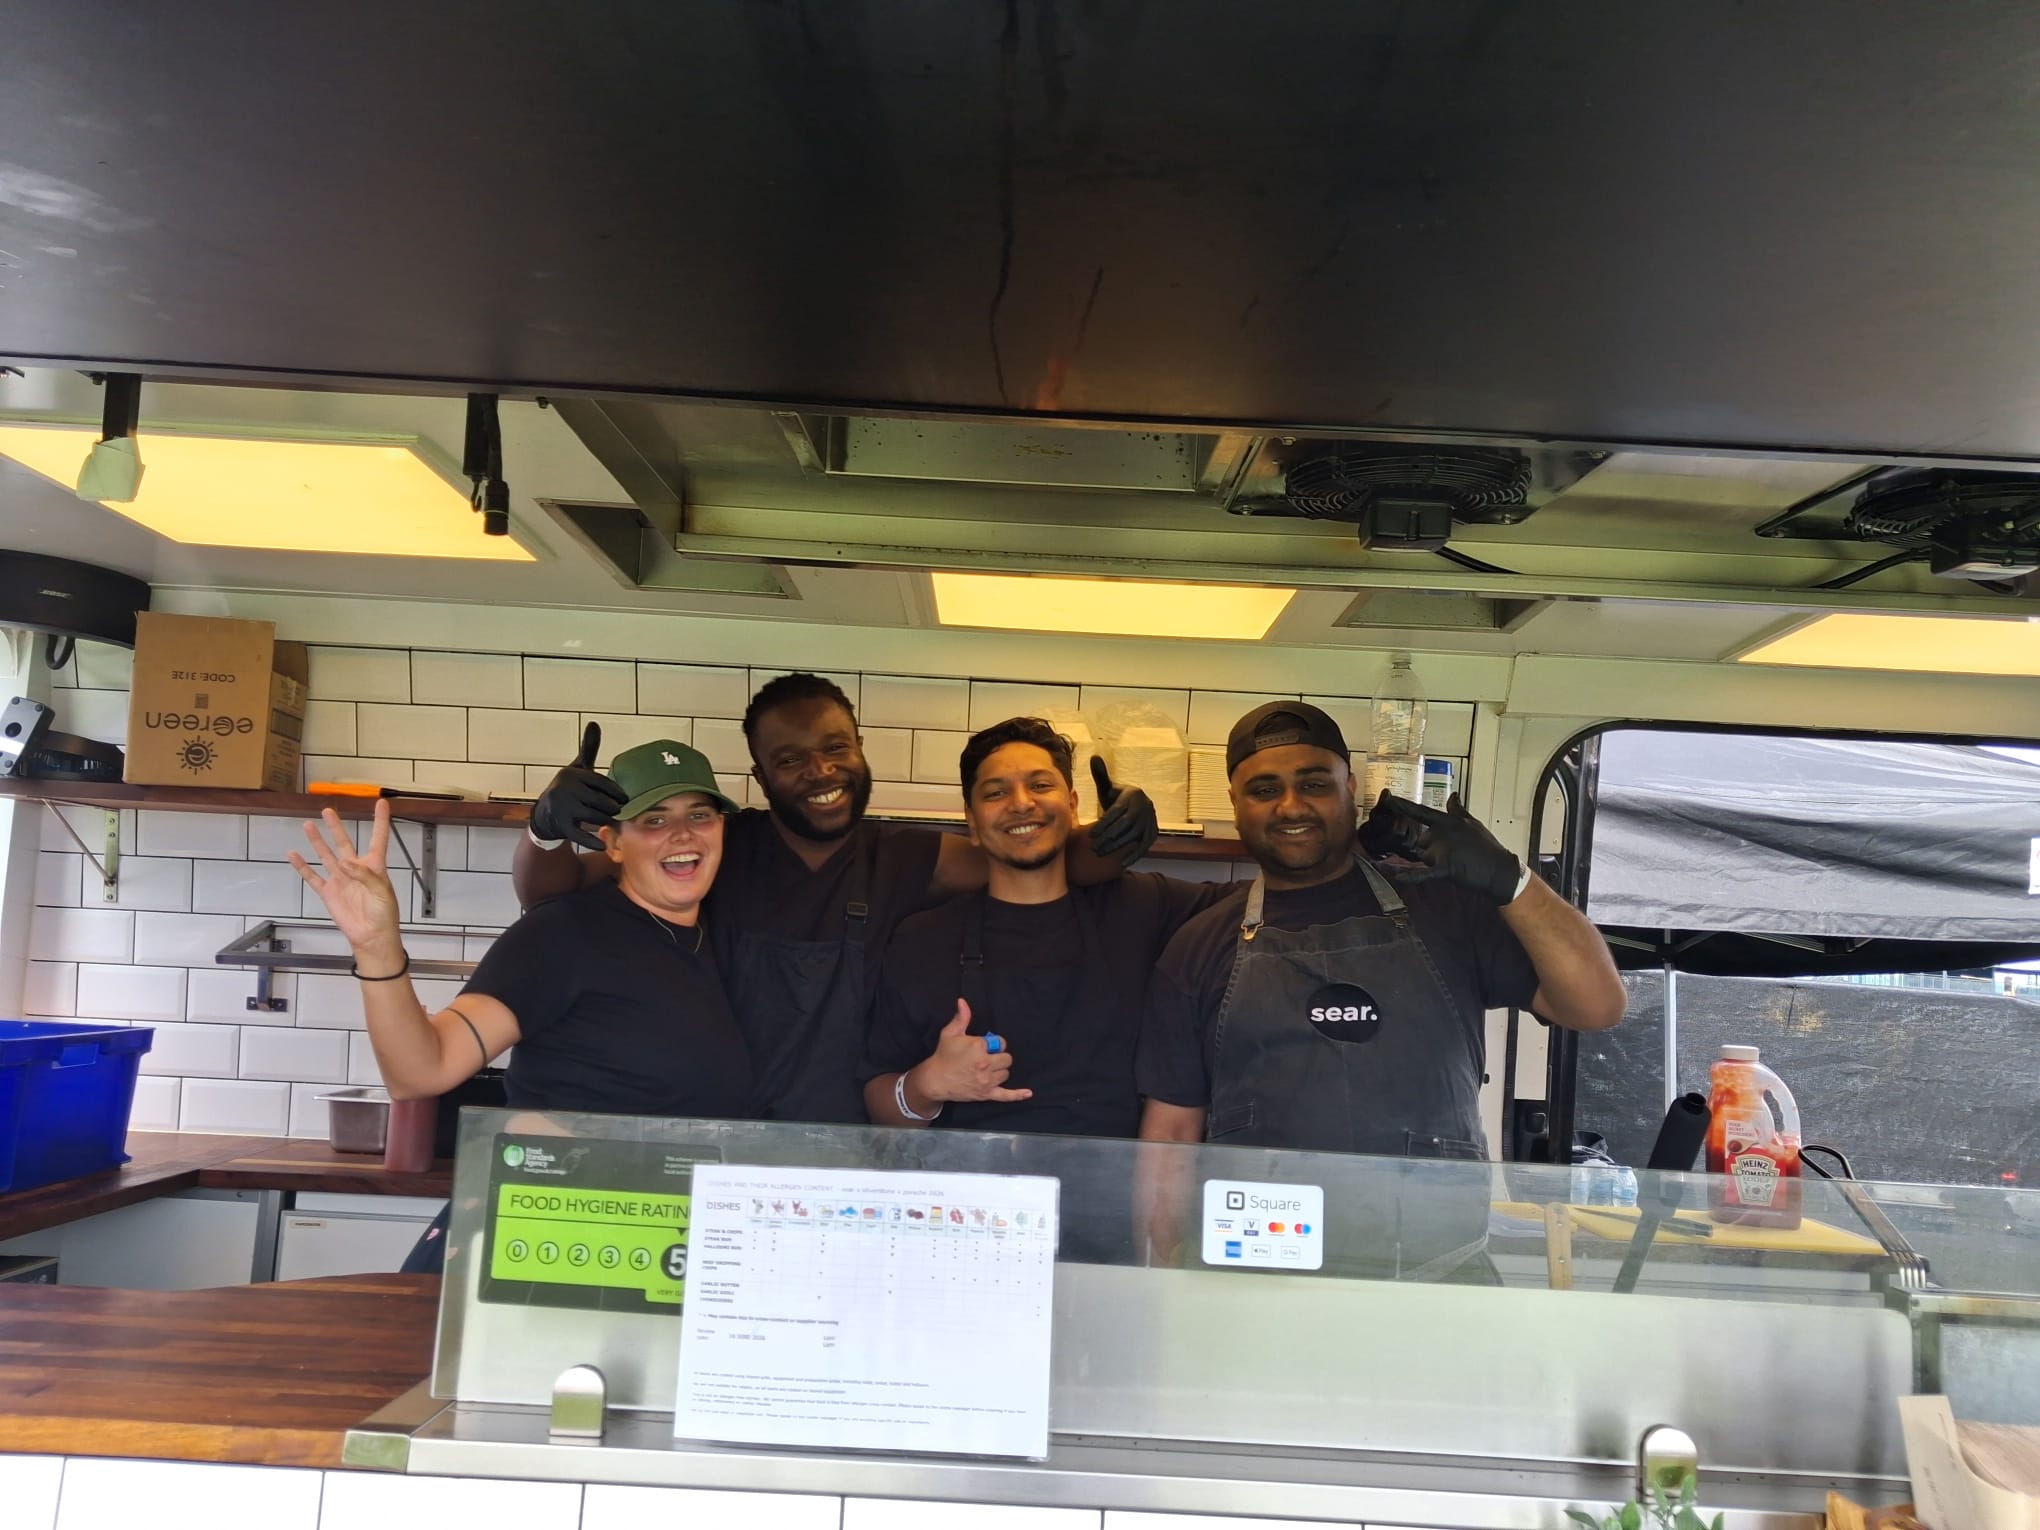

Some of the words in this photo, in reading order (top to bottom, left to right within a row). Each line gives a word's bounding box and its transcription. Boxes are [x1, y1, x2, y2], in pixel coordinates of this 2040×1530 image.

[170, 670, 198, 681] 312E
[199, 672, 236, 683] CODE:
[144, 711, 254, 737] eGreen
[1310, 1005, 1378, 1022] sear.
[1742, 1160, 1769, 1169] HEINZ
[510, 1194, 561, 1211] FOOD
[565, 1197, 638, 1216] HYGIENE
[641, 1203, 690, 1220] RATIN
[706, 1201, 741, 1211] DISHES
[1250, 1195, 1301, 1212] Square
[668, 1248, 687, 1277] 5
